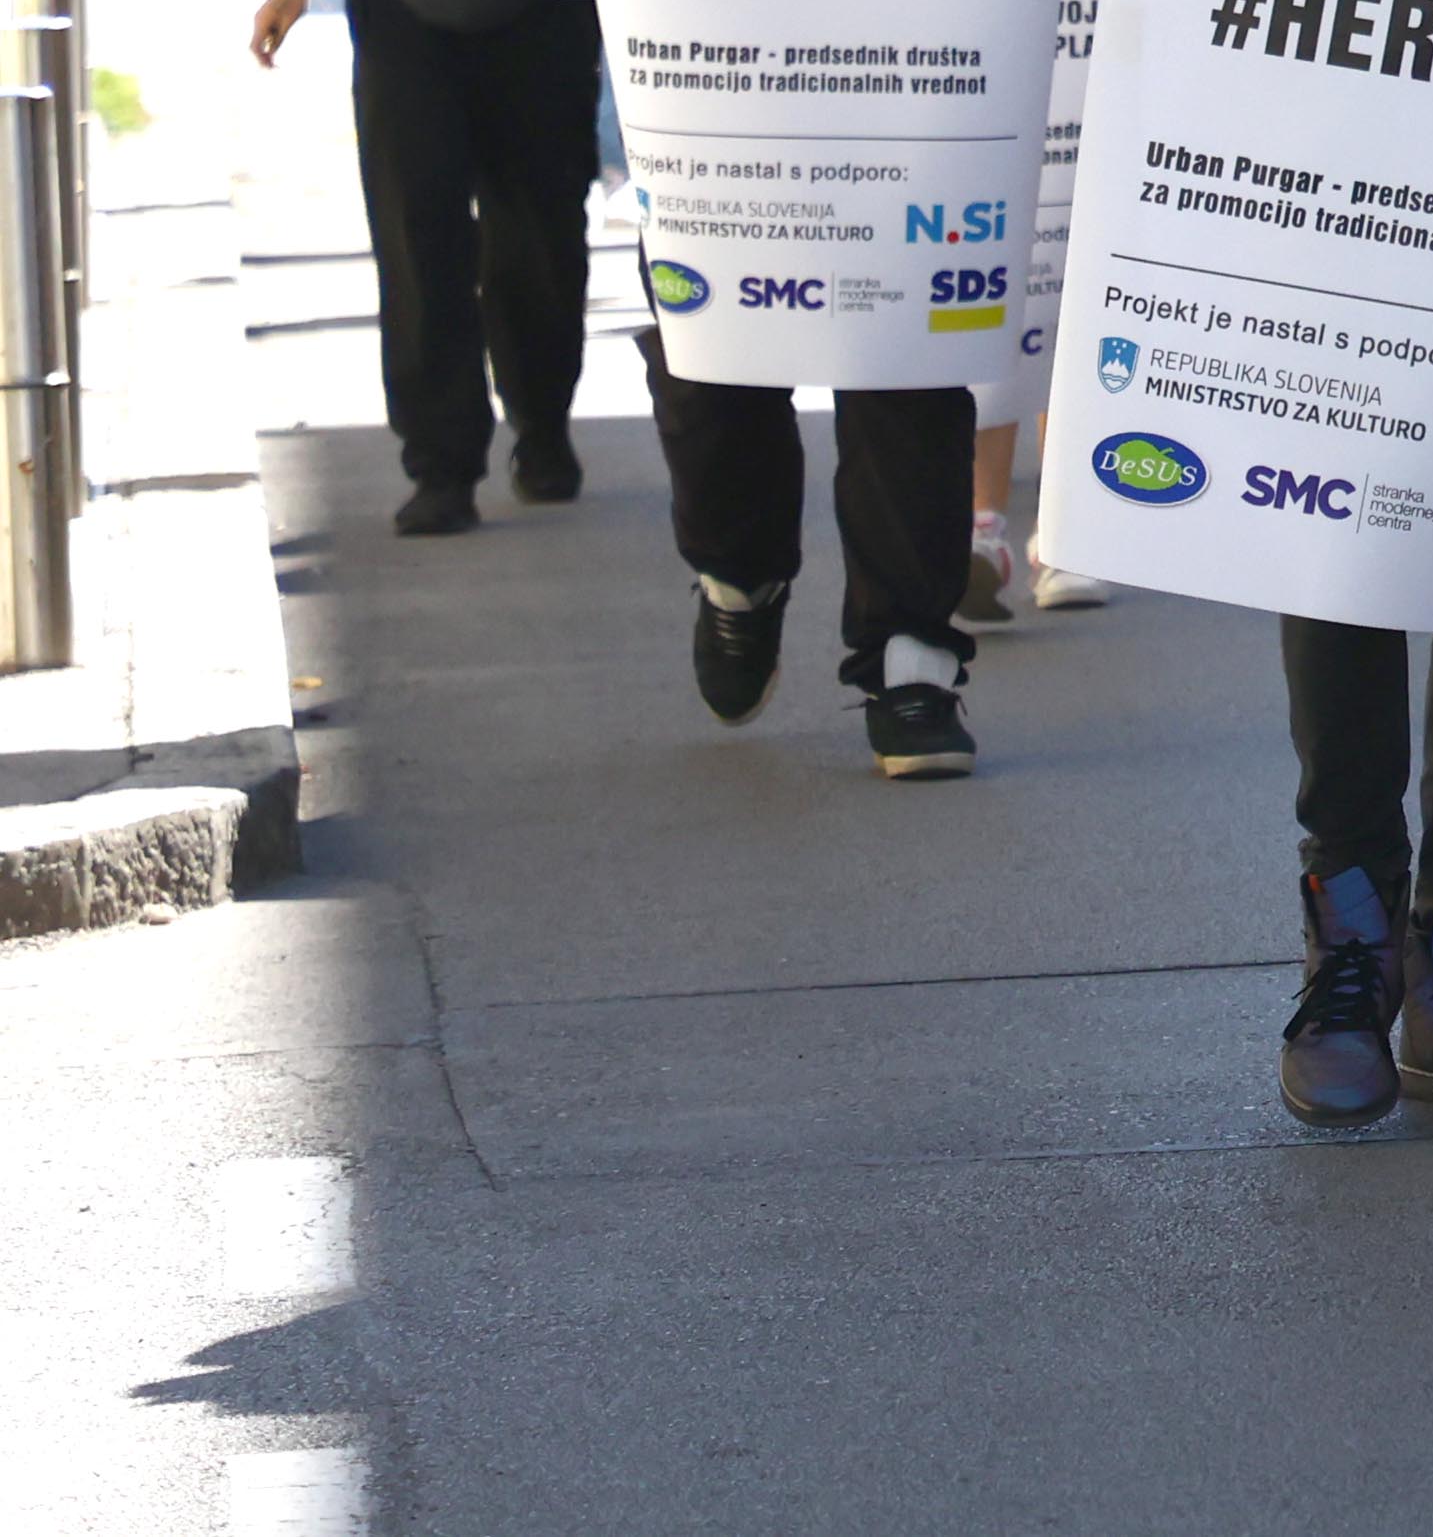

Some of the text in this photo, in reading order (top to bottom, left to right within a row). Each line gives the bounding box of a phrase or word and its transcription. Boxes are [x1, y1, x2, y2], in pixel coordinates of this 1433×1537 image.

[627, 37, 981, 67] Urban Purgar predsednik društva
[629, 68, 987, 95] za promocijo tradicionalnih vrednot
[628, 149, 908, 185] Projekt je nastal s podporo:
[1146, 140, 1225, 179] Urban
[1232, 155, 1325, 195] Purgar
[656, 194, 836, 222] REPUBLIKA SLOVENIJA
[905, 201, 1006, 245] N.Si
[1139, 181, 1170, 206] za
[1177, 187, 1307, 229] promocijo
[657, 216, 874, 242] MINISTRSTVO ZA KULTURO
[739, 276, 826, 311] SMC
[929, 267, 1008, 303] SDS
[1104, 285, 1199, 325] Projekt
[1203, 304, 1232, 333] je
[1242, 315, 1326, 346] nastal
[1334, 331, 1349, 350] s
[1150, 348, 1382, 407] REPUBLIKA SLOVENIJA
[1145, 376, 1427, 442] MINISTRSTVO ZA KULTURO
[1099, 449, 1197, 488] DeSUS
[1241, 464, 1356, 521] SMC
[1372, 484, 1425, 504] stranka
[1367, 513, 1413, 532] centra
